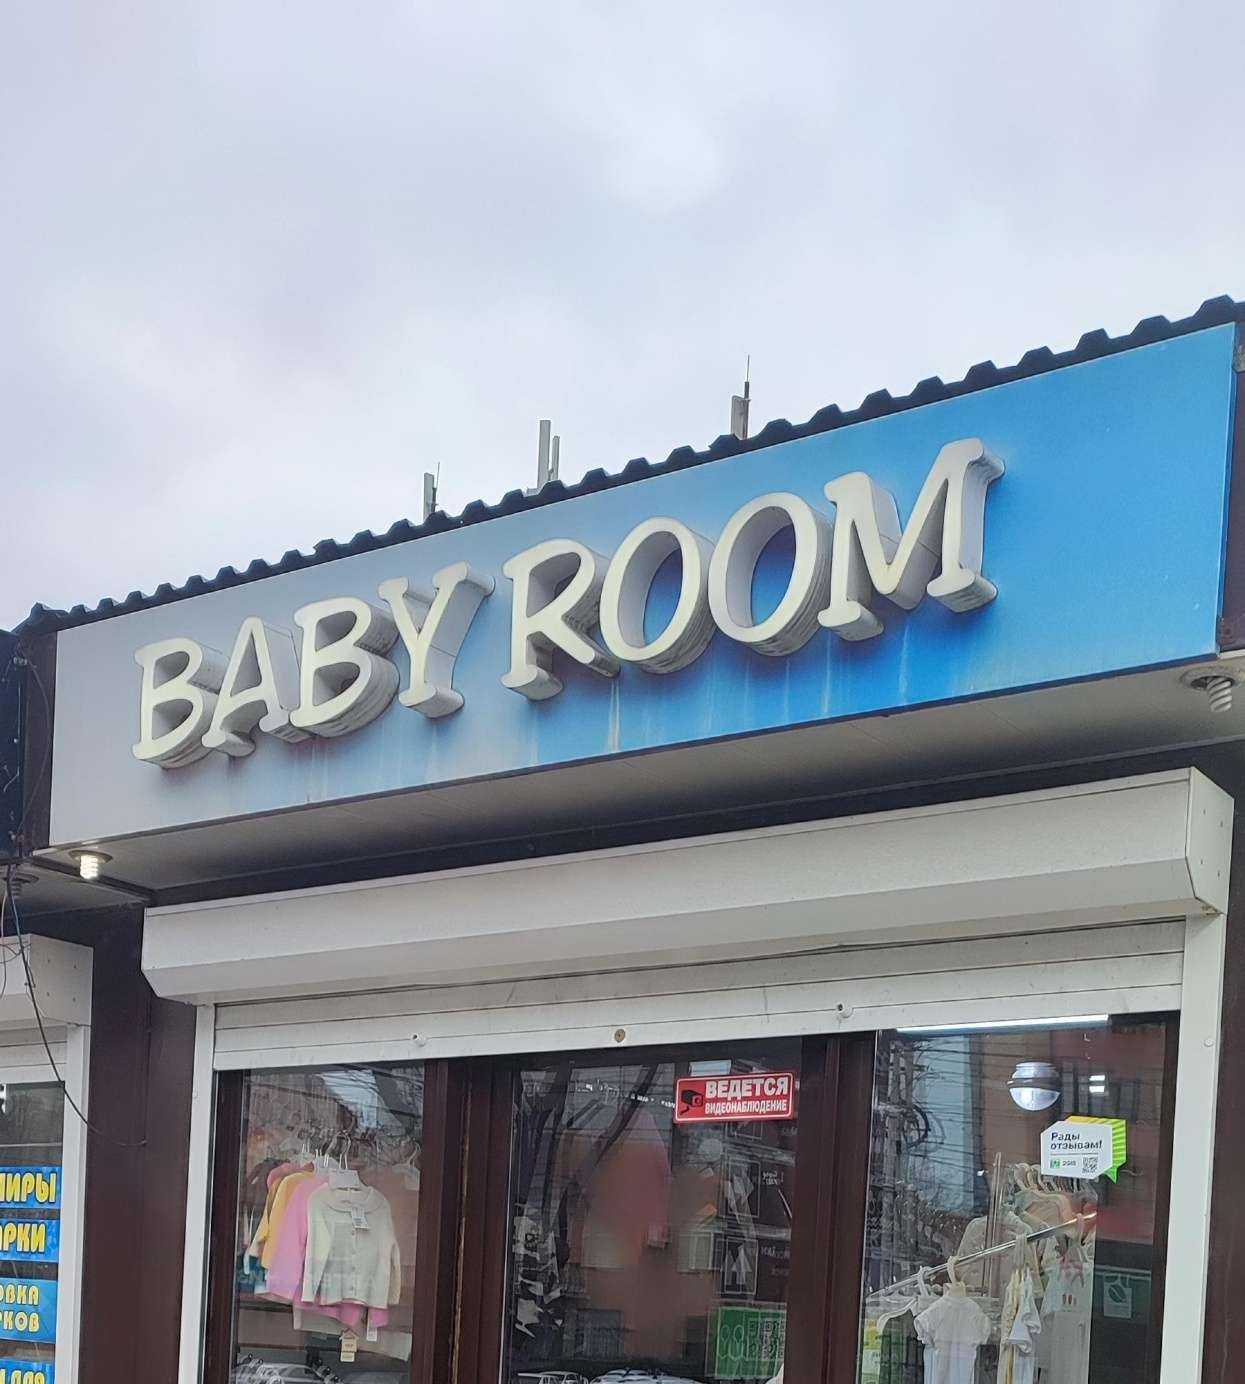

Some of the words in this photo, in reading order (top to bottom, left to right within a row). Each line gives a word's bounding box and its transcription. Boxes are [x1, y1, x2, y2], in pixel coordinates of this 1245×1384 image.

[132, 562, 493, 769] BABY
[501, 438, 1004, 700] ROOM
[705, 1077, 788, 1101] ВЕДЕТСЯ
[705, 1099, 787, 1115] ВИДЕОНАБЛЮДЕНИЕ
[1050, 1140, 1102, 1150] отзывам!
[1051, 1132, 1080, 1142] Рады
[0, 1222, 46, 1253] РКИ
[0, 1310, 40, 1333] КОВ
